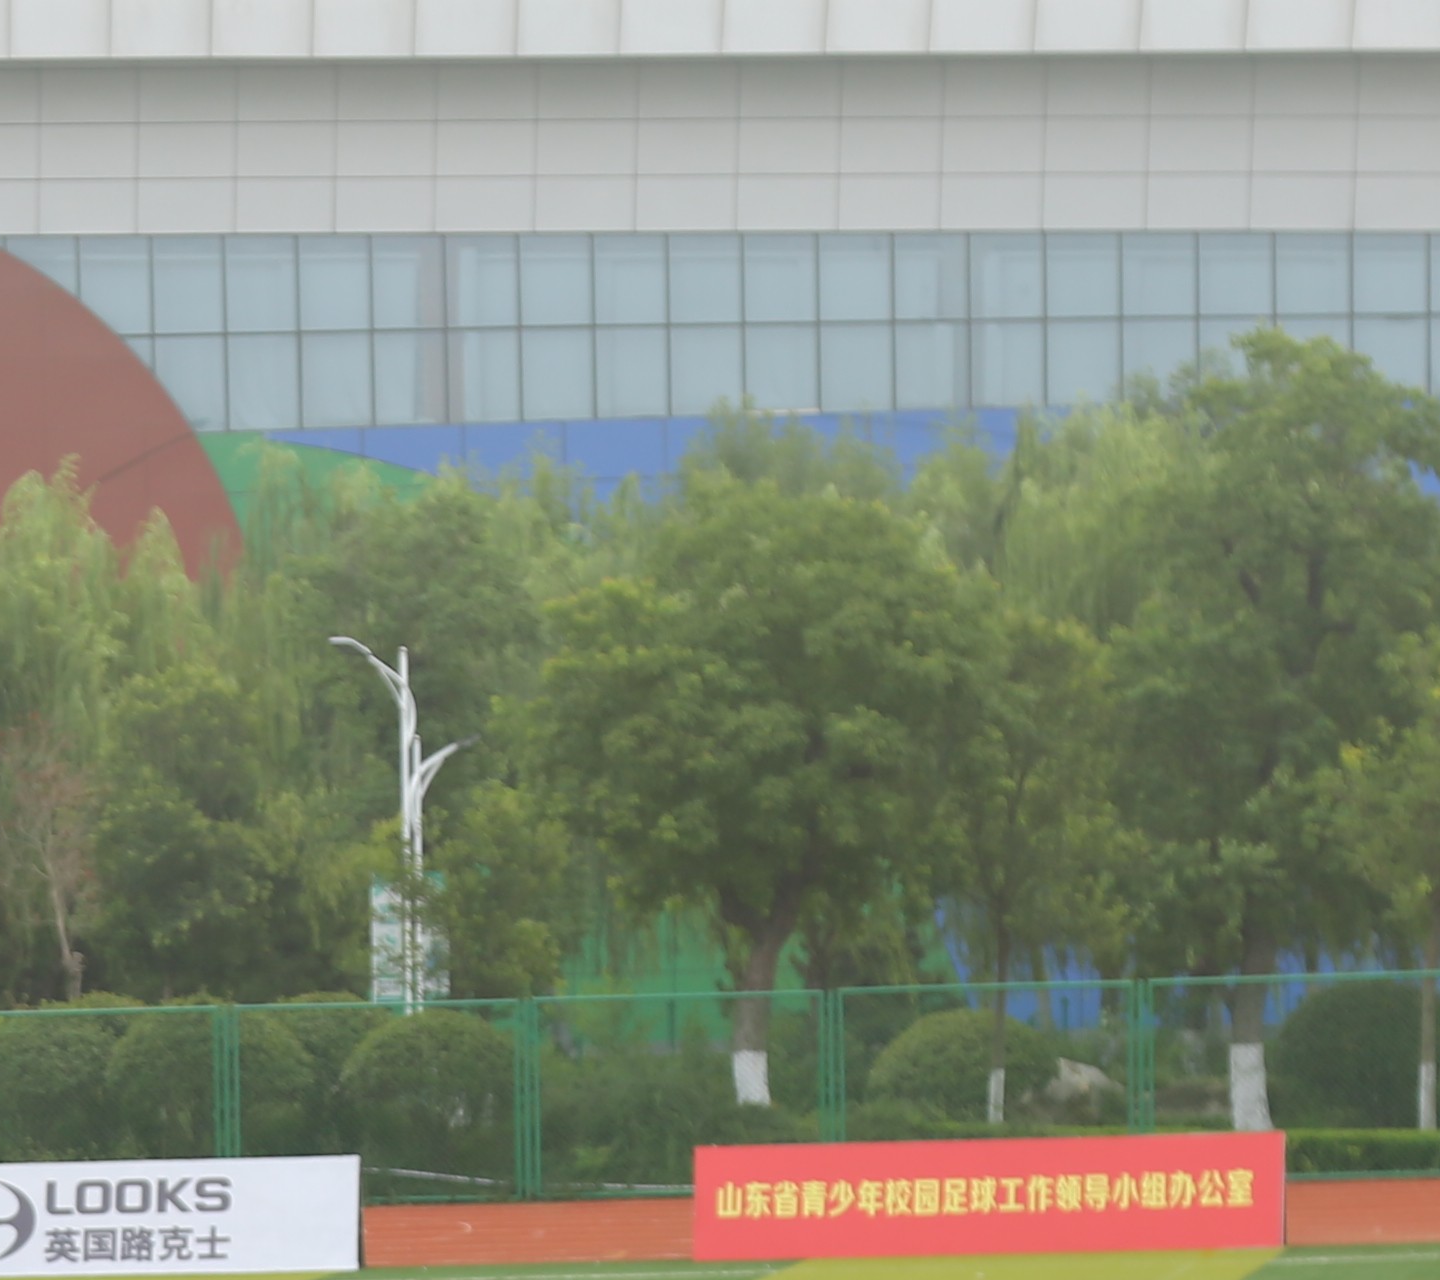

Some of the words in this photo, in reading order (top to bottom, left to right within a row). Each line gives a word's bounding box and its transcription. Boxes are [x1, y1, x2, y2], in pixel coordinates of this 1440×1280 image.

[44, 1177, 232, 1215] LOOKS
[716, 1168, 1255, 1219] 山东省青少年校园足球工作领导小组办公室
[43, 1226, 231, 1263] 英国路克士
